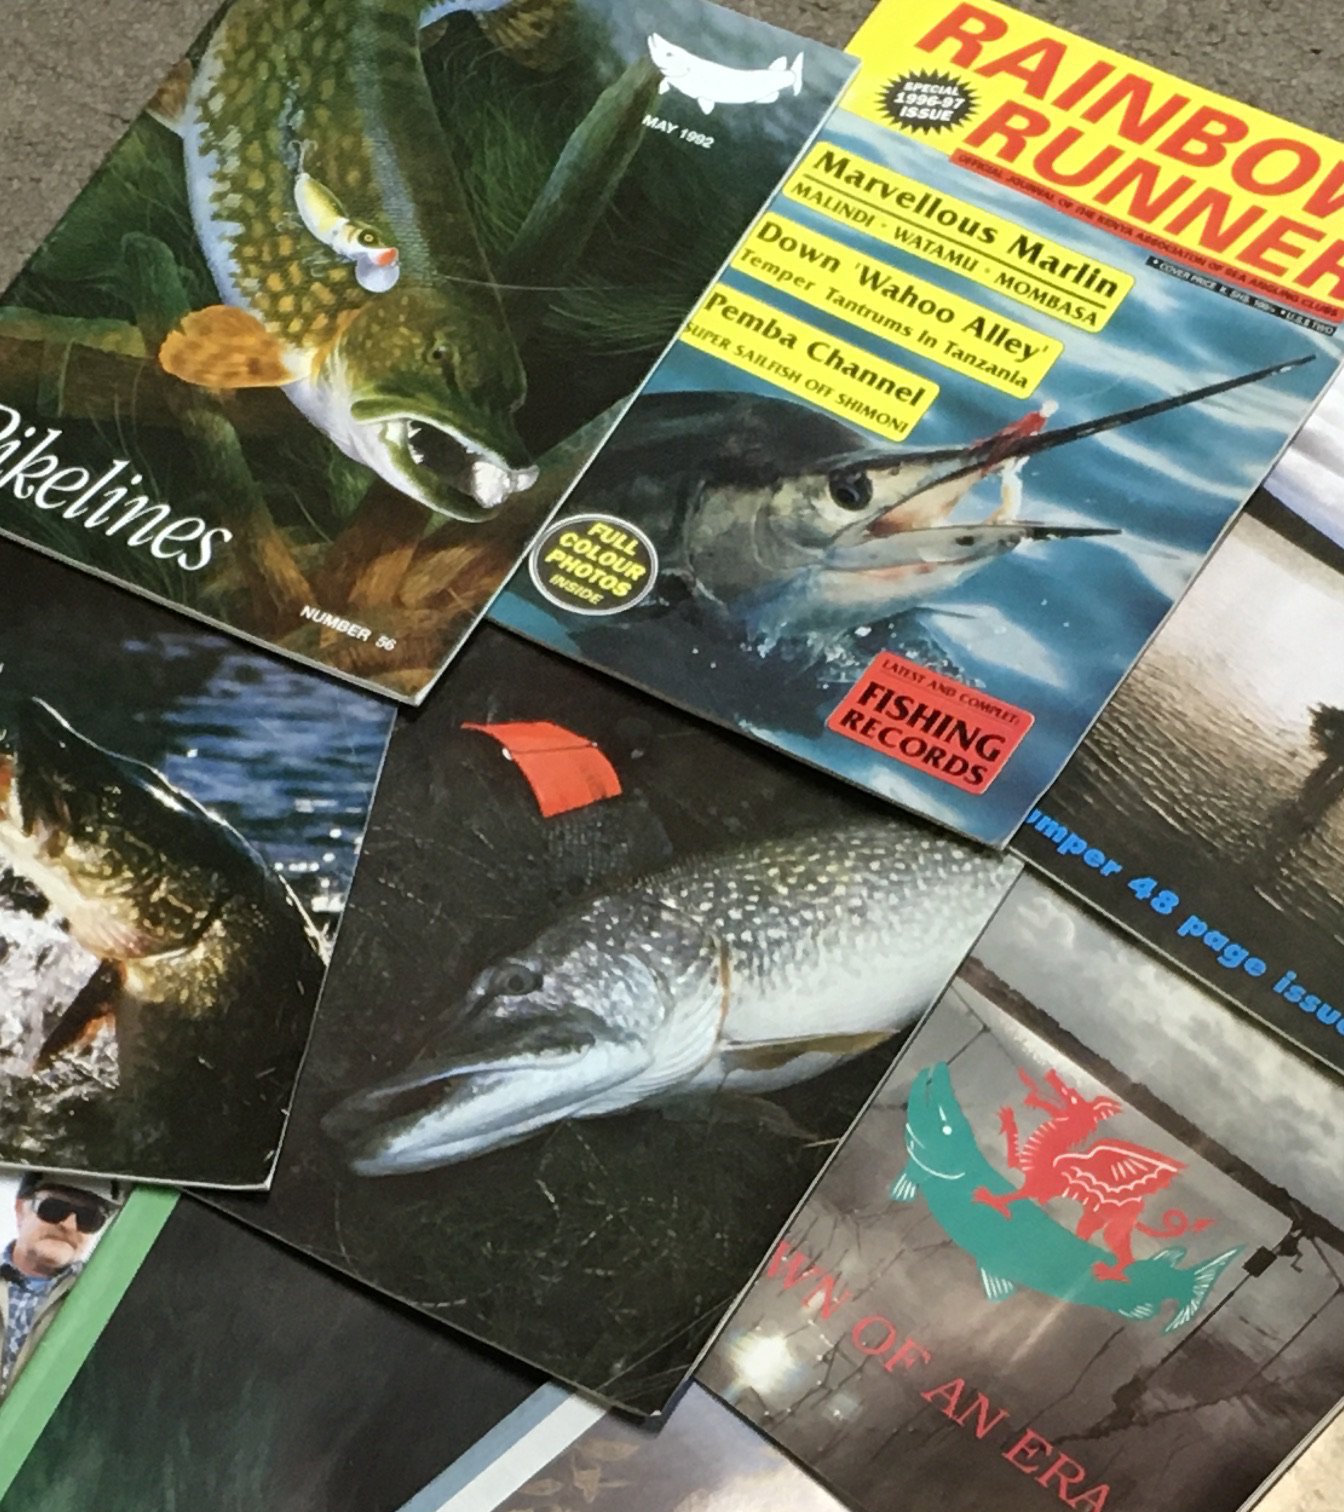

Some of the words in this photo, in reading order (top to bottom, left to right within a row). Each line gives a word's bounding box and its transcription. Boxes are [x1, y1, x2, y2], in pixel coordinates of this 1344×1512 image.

[893, 92, 965, 110] 1996-97
[899, 106, 954, 122] ISSUE
[903, 82, 960, 97] SPECIAL
[641, 114, 679, 134] MAY
[791, 182, 875, 228] MALINDI
[893, 226, 978, 274] WATAMU
[994, 271, 1098, 327] MOMBASA
[813, 151, 998, 247] Marvellous
[1007, 234, 1118, 299] Marlin
[740, 248, 817, 292] Temper
[825, 286, 924, 340] Tantrums
[919, 330, 938, 349] In
[757, 222, 841, 273] Down
[854, 262, 956, 325] 'Wahoo
[685, 321, 730, 352] SUPER
[734, 342, 802, 384] SAILFISH
[805, 375, 834, 399] OFF
[834, 390, 909, 434] SHIMONI
[703, 291, 798, 350] Pemba
[807, 340, 926, 407] Channel
[558, 532, 647, 582] COLOUR
[586, 521, 639, 557] FULL
[544, 547, 633, 599] PHOTOS
[549, 574, 605, 605] INSIDE
[300, 604, 373, 642] NUMBER
[375, 633, 398, 653] 56
[881, 658, 926, 684] LATEST
[928, 677, 957, 698] AND
[839, 708, 988, 786] RECORDS
[857, 680, 1006, 762] FISHING
[1127, 876, 1180, 915] 48
[1176, 914, 1267, 977] page
[851, 1314, 932, 1373] OF
[920, 1377, 1010, 1440] AN
